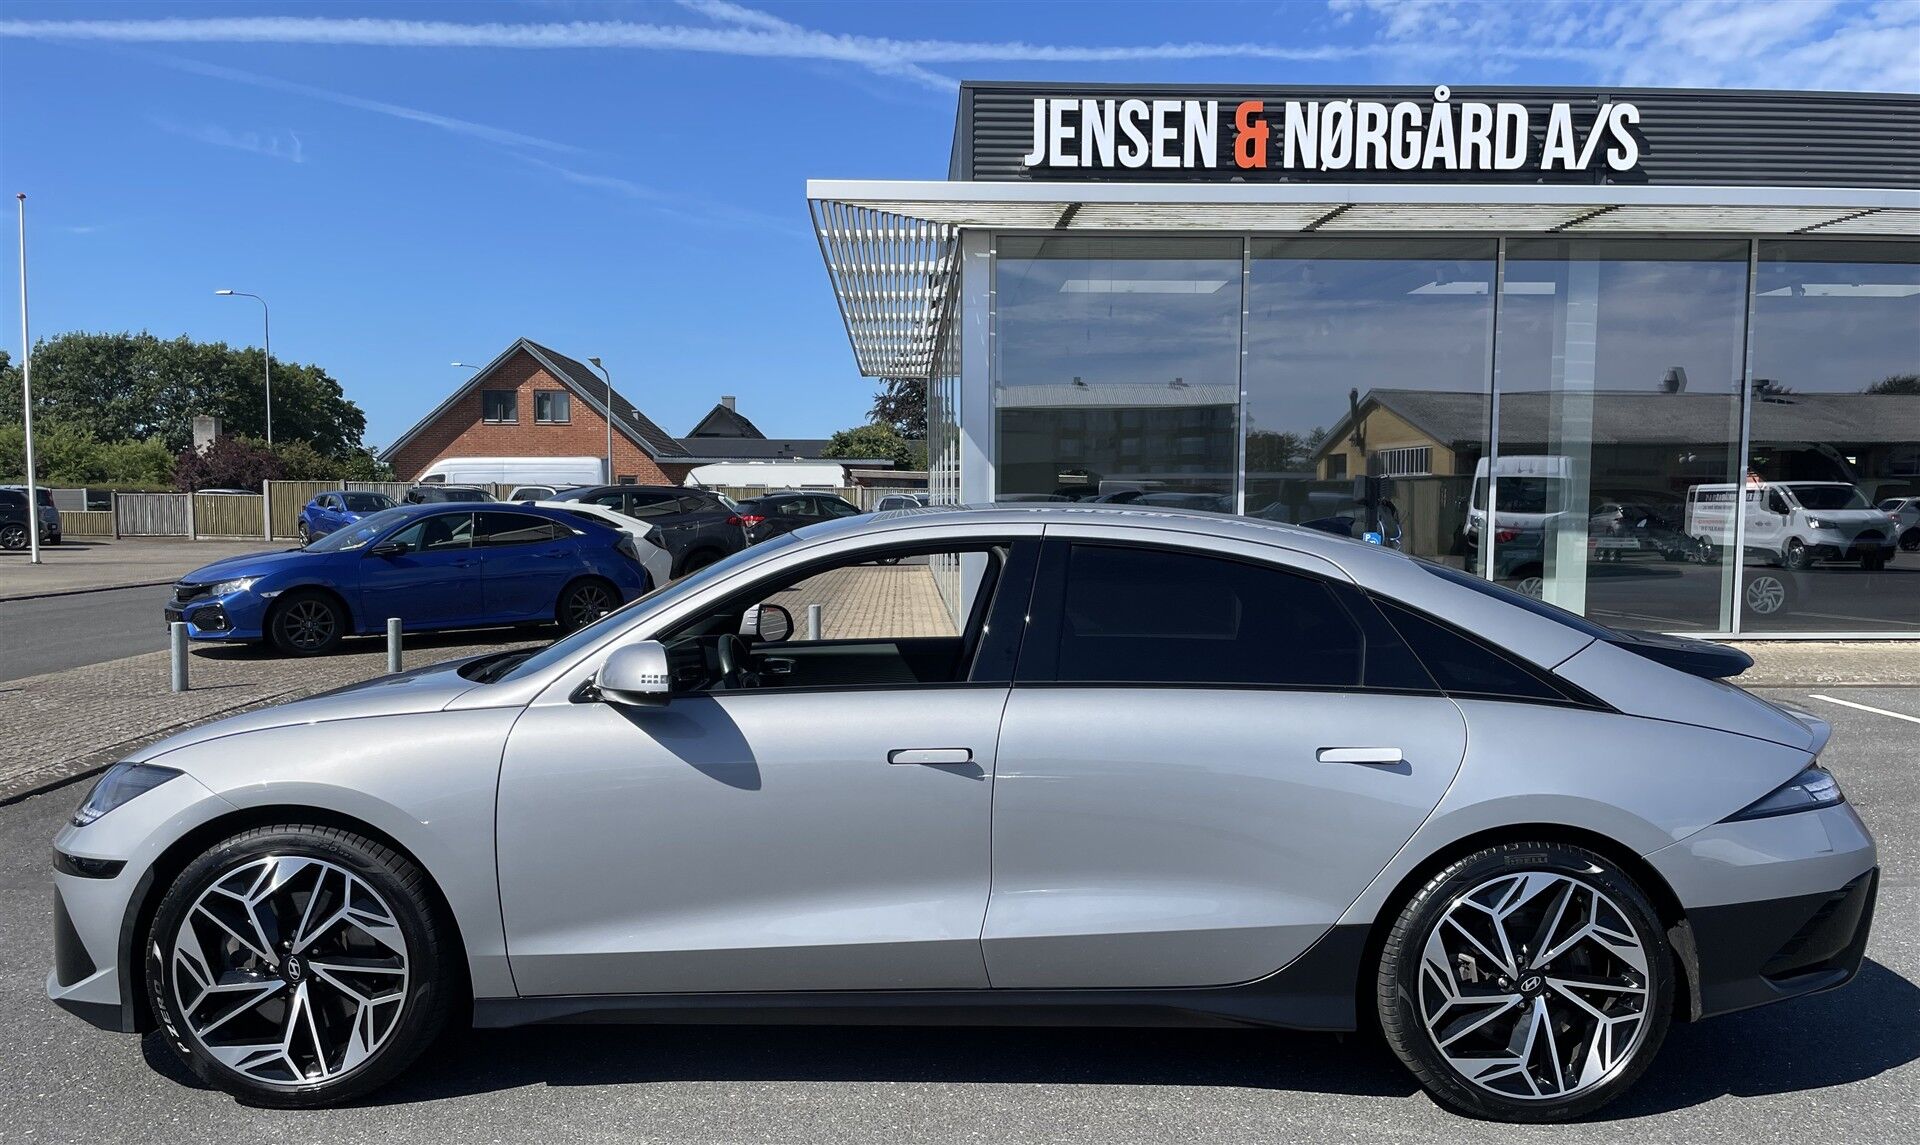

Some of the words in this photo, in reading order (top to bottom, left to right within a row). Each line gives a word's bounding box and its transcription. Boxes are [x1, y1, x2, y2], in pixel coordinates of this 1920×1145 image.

[1024, 98, 1218, 168] JENSEN
[1234, 101, 1268, 169] &
[1283, 84, 1529, 172] NØRGÅRD
[1541, 102, 1640, 171] A/S
